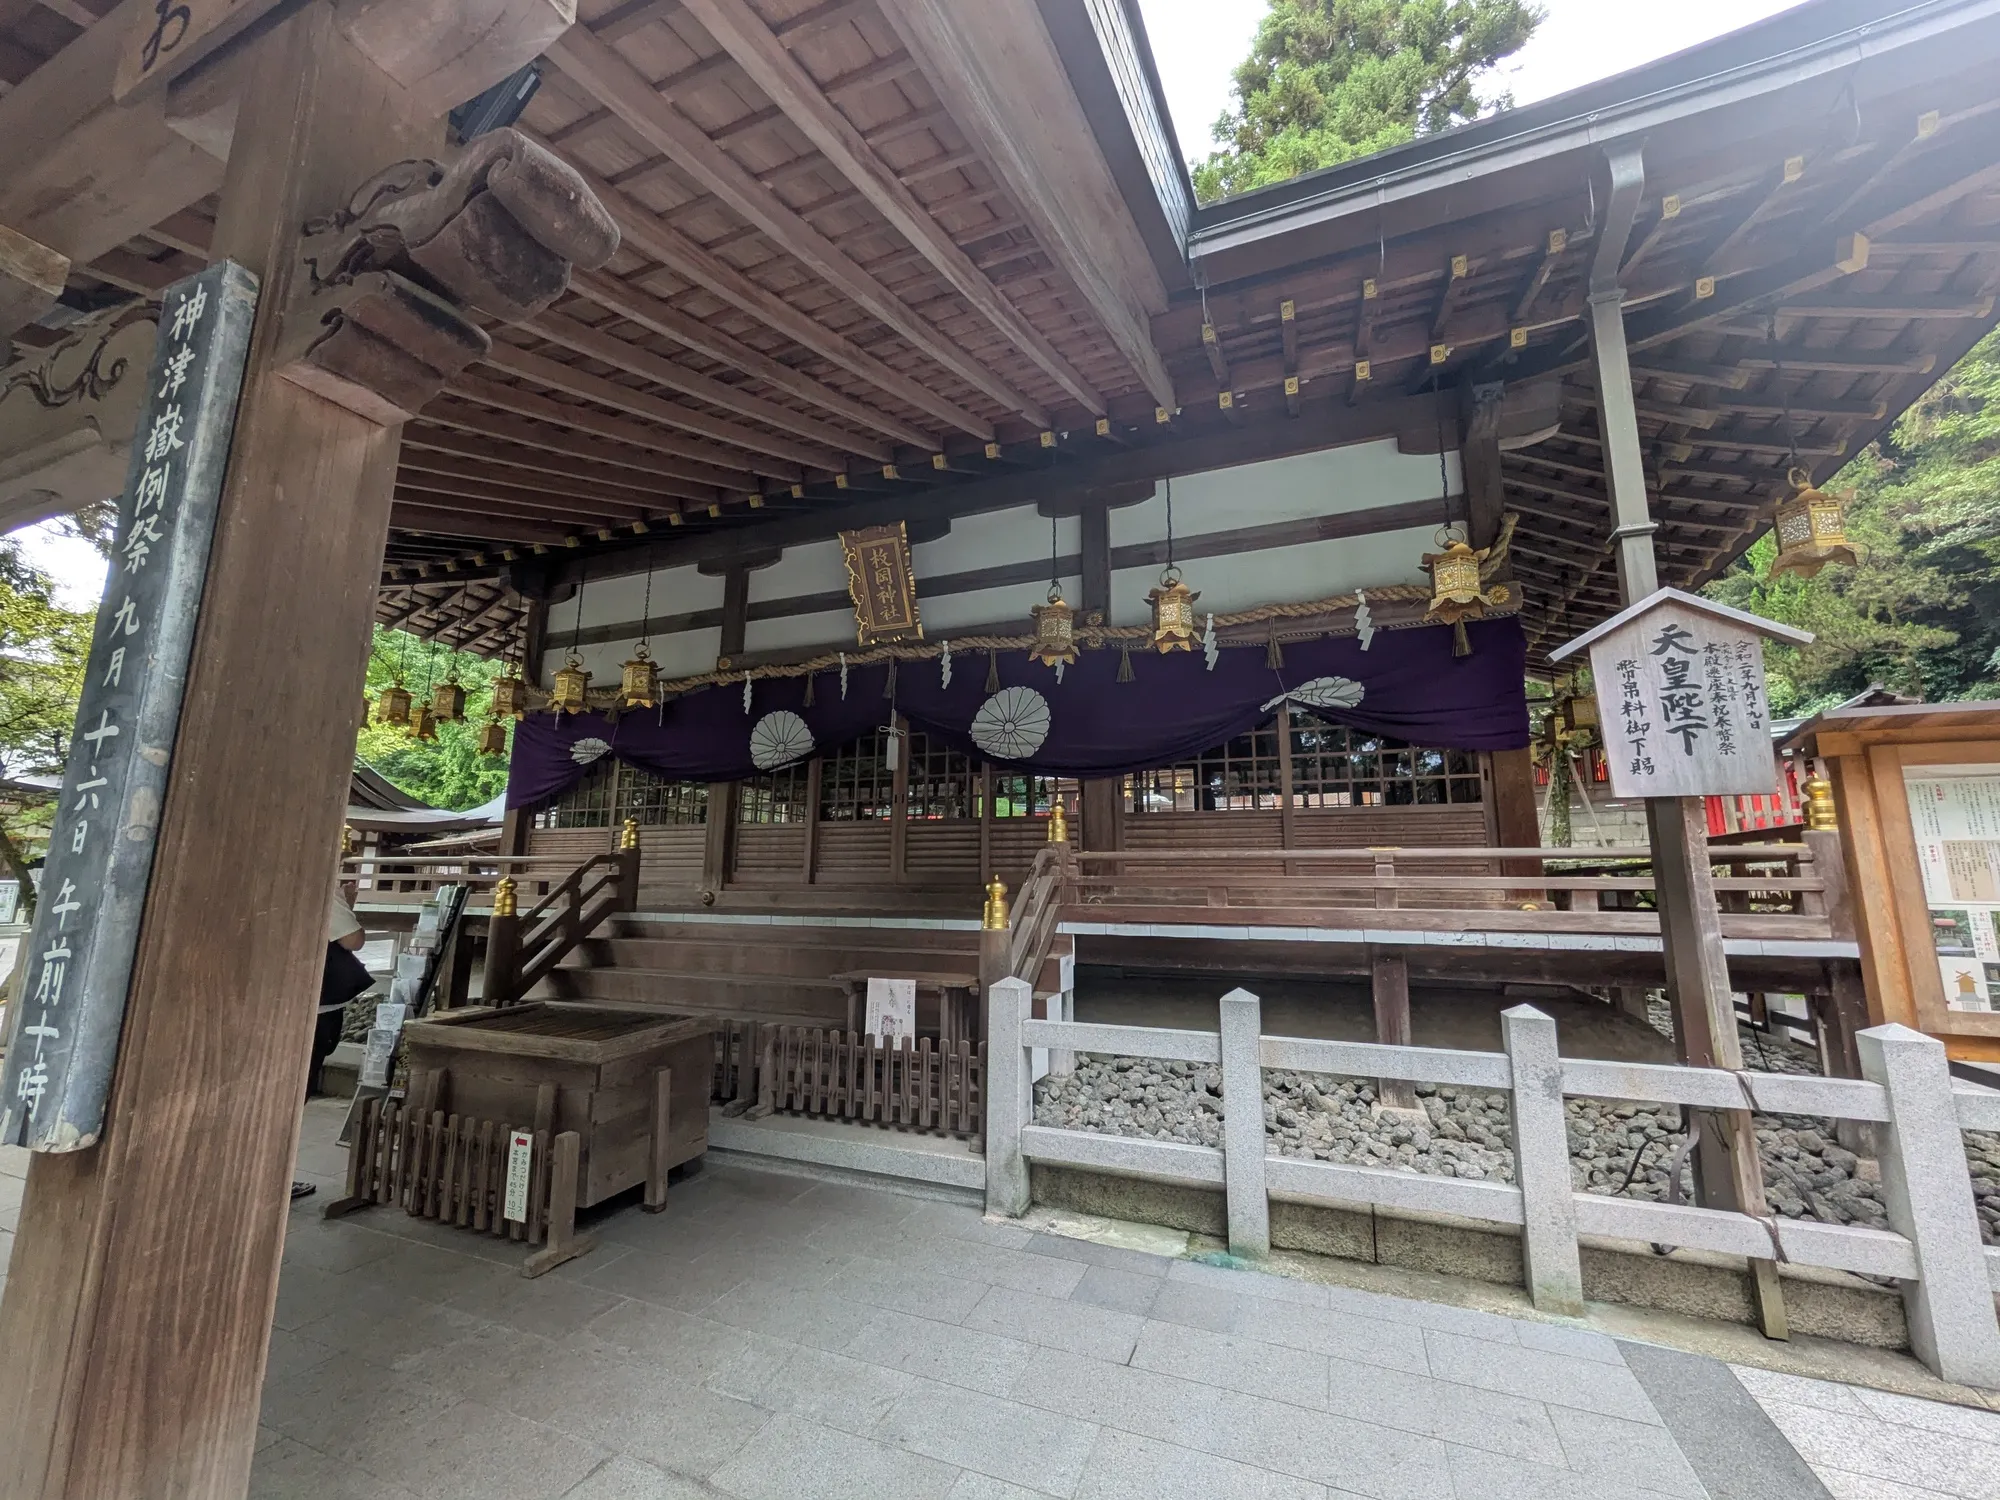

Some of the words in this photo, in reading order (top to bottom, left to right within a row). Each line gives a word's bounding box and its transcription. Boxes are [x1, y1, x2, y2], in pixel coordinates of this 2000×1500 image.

[122, 291, 206, 574] 神津嶽例祭
[71, 595, 142, 856] 九月十六日
[1616, 658, 1655, 775] 幣帛料御下賜
[1650, 623, 1708, 756] 天皇陛下
[1735, 639, 1763, 730] 令和二年九月十九日
[17, 878, 82, 1123] 午前十時
[518, 1151, 527, 1213] かみつだけコース
